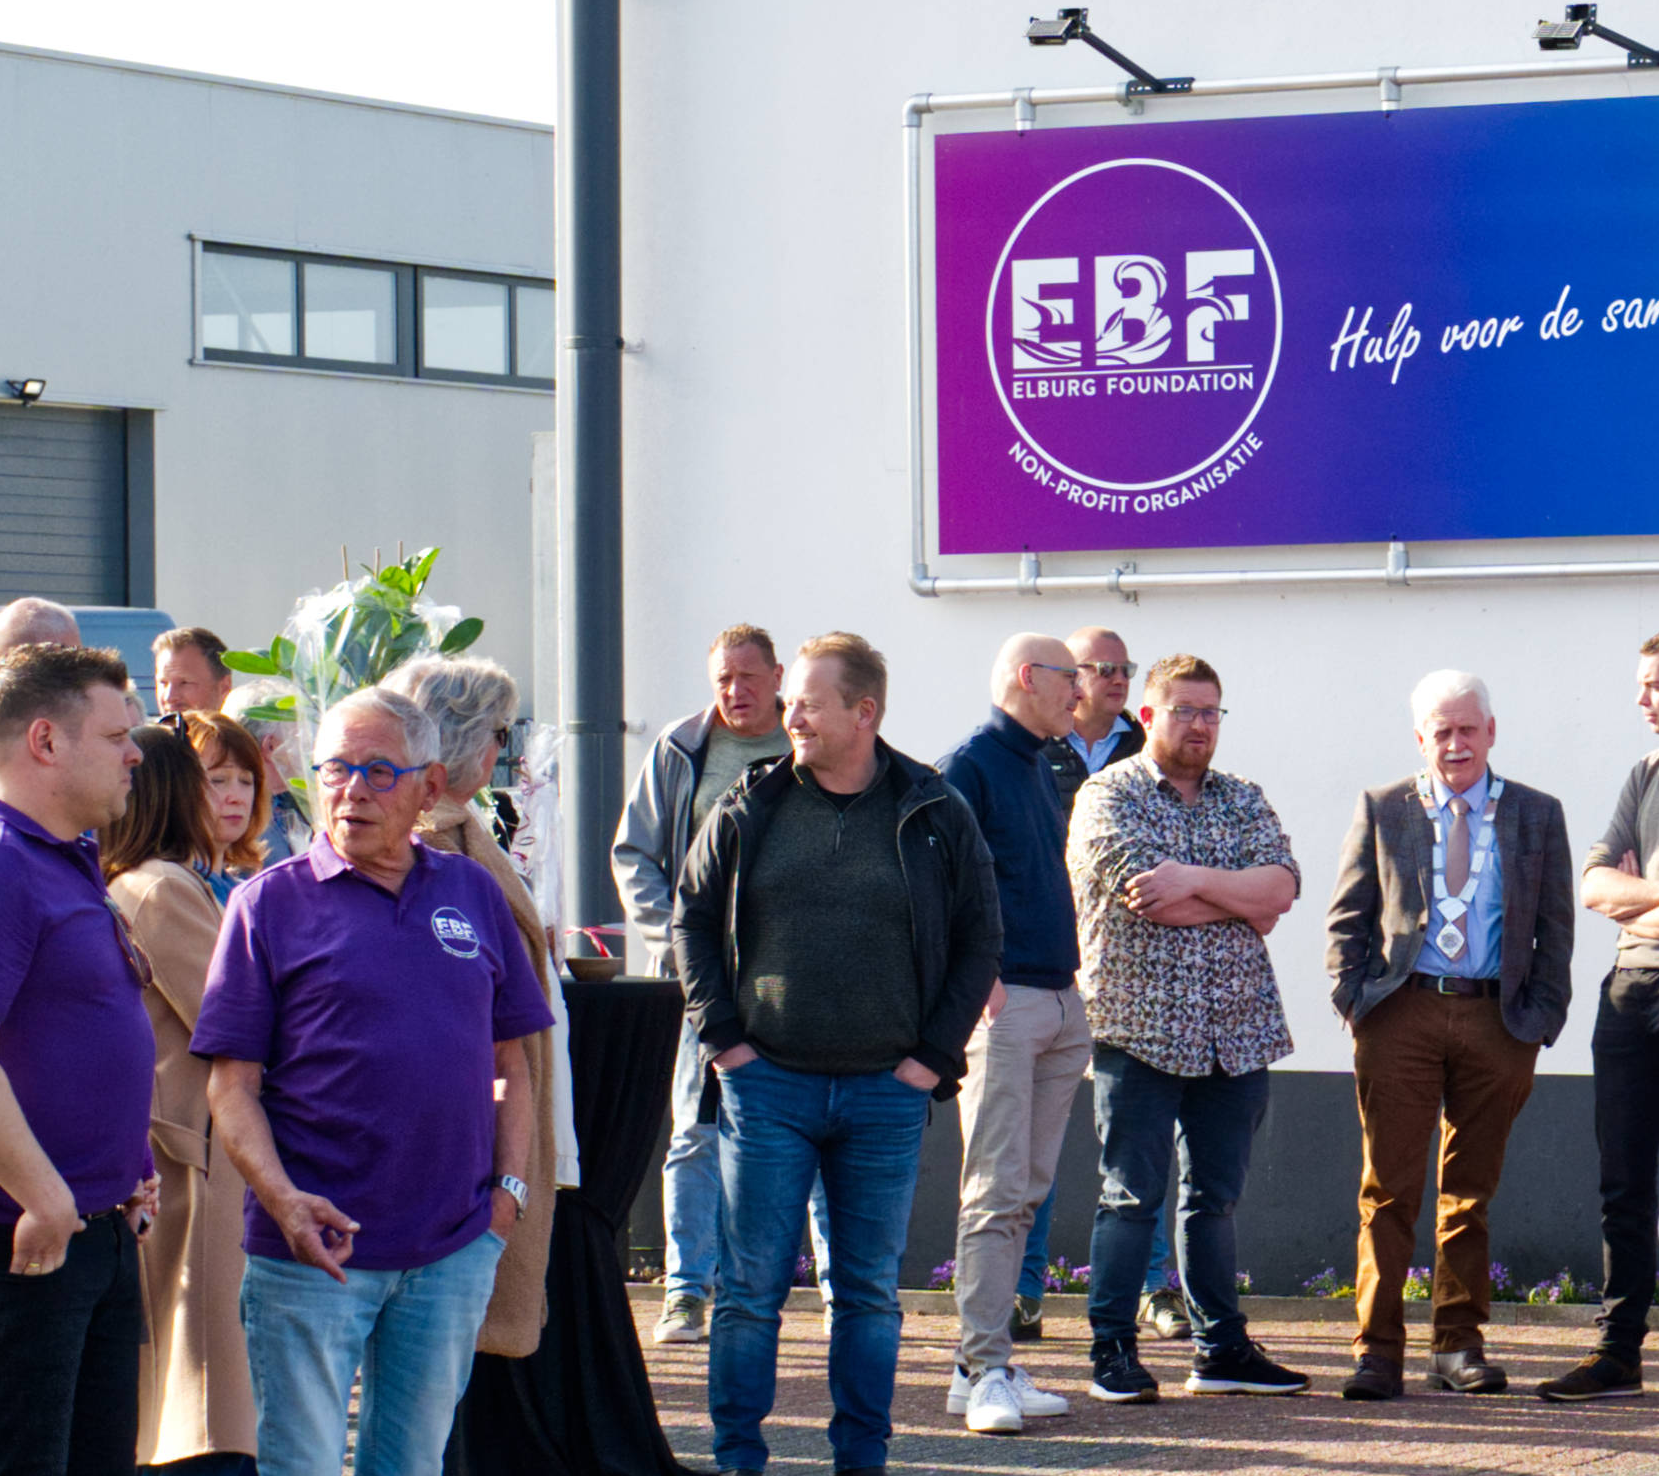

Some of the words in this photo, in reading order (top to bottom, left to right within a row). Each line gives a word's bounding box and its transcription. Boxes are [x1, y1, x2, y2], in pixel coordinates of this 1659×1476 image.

[1011, 248, 1255, 370] EBF
[1330, 302, 1421, 385] Hulp
[1439, 315, 1524, 354] voor
[1539, 284, 1584, 340] de
[1012, 378, 1097, 399] ELBURG
[1106, 371, 1255, 395] FOUNDATION
[1008, 440, 1129, 514] NON-PROFIT
[1133, 431, 1263, 513] ORGANISATIE
